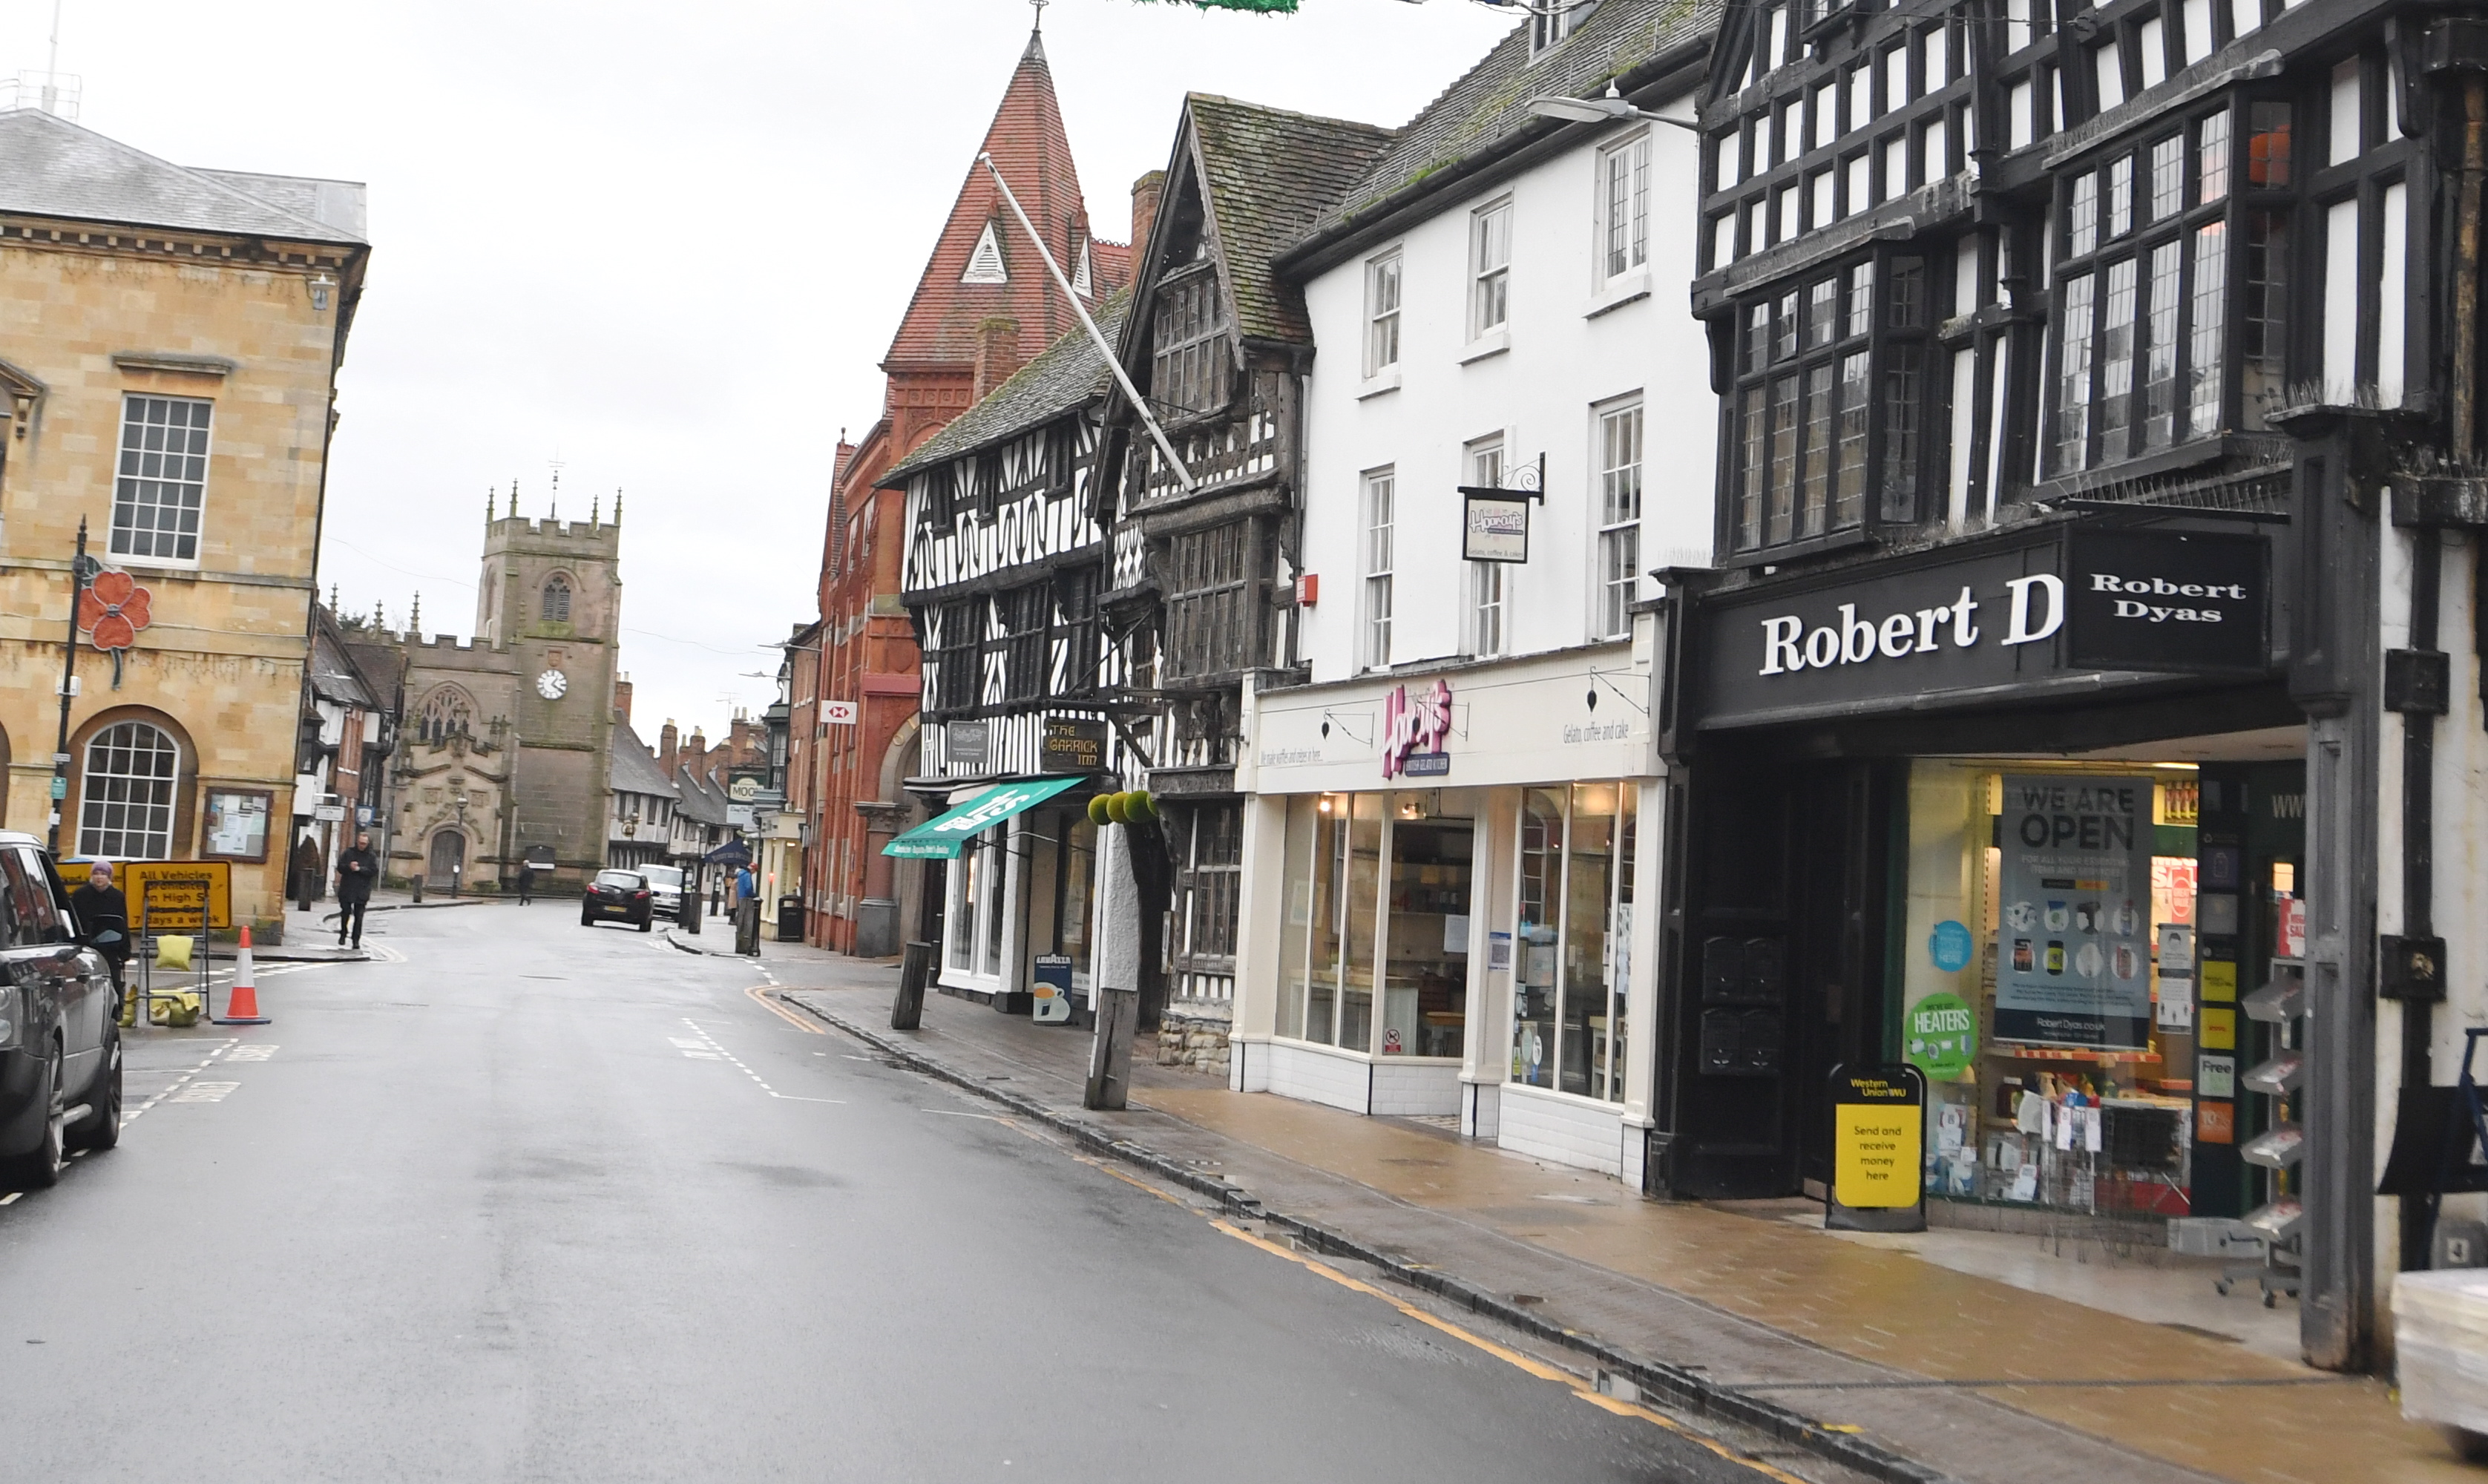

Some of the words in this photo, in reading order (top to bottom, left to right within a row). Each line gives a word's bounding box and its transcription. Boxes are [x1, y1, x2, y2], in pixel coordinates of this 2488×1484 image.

[1468, 508, 1523, 533] Hooray's
[2090, 574, 2247, 600] Robert
[2113, 600, 2223, 623] Dyas
[1759, 586, 1979, 675] Robert
[2000, 574, 2064, 646] D
[1050, 724, 1076, 737] THE
[1583, 721, 1601, 742] coffee
[1602, 719, 1614, 741] and
[1615, 718, 1629, 739] cake
[1049, 738, 1098, 753] GARRICK
[2023, 787, 2066, 810] WE
[2075, 787, 2134, 813] ARE
[2020, 814, 2134, 850] OPEN
[140, 871, 157, 880] All
[160, 870, 213, 880] Vehicles
[163, 893, 191, 902] High
[134, 916, 141, 925] 7
[1036, 953, 1071, 964] LAVAZZA
[1914, 1009, 1970, 1034] HEATERS
[2202, 1060, 2232, 1074] Free
[1851, 1078, 1888, 1088] Western
[1862, 1088, 1888, 1097] Union
[1854, 1126, 1880, 1136] Send
[1881, 1127, 1902, 1136] and
[1860, 1142, 1896, 1151] receive
[1860, 1158, 1894, 1166] money
[1865, 1170, 1889, 1181] here
